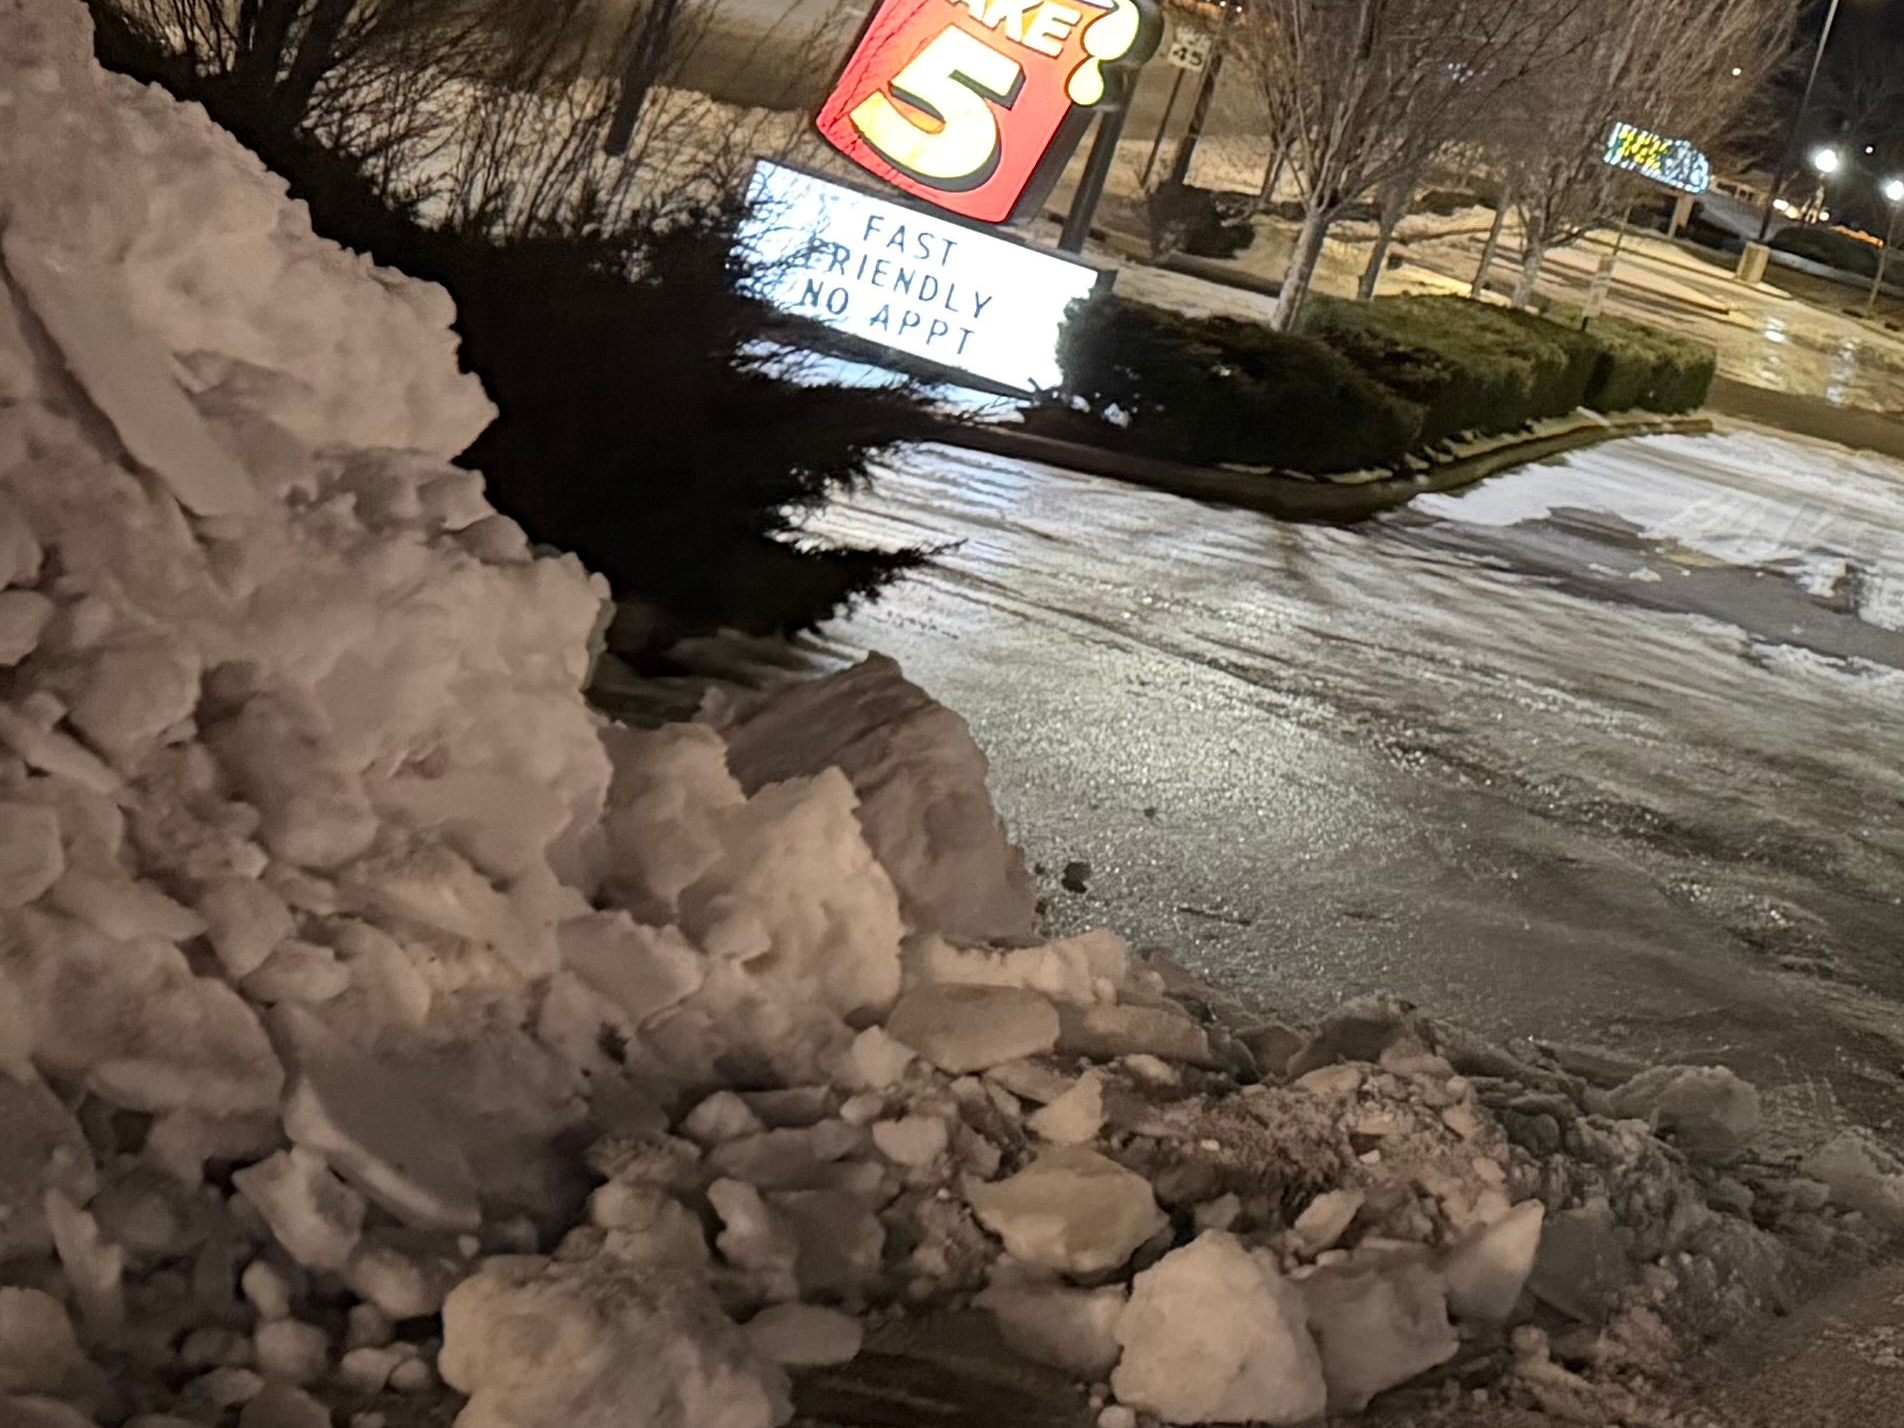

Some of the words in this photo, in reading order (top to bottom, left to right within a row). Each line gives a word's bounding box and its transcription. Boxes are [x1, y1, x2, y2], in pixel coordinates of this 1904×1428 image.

[850, 24, 1024, 184] 5
[807, 237, 993, 319] FRIENDLY
[863, 215, 958, 267] FAST
[800, 278, 850, 316] NO
[869, 304, 975, 355] APPT
